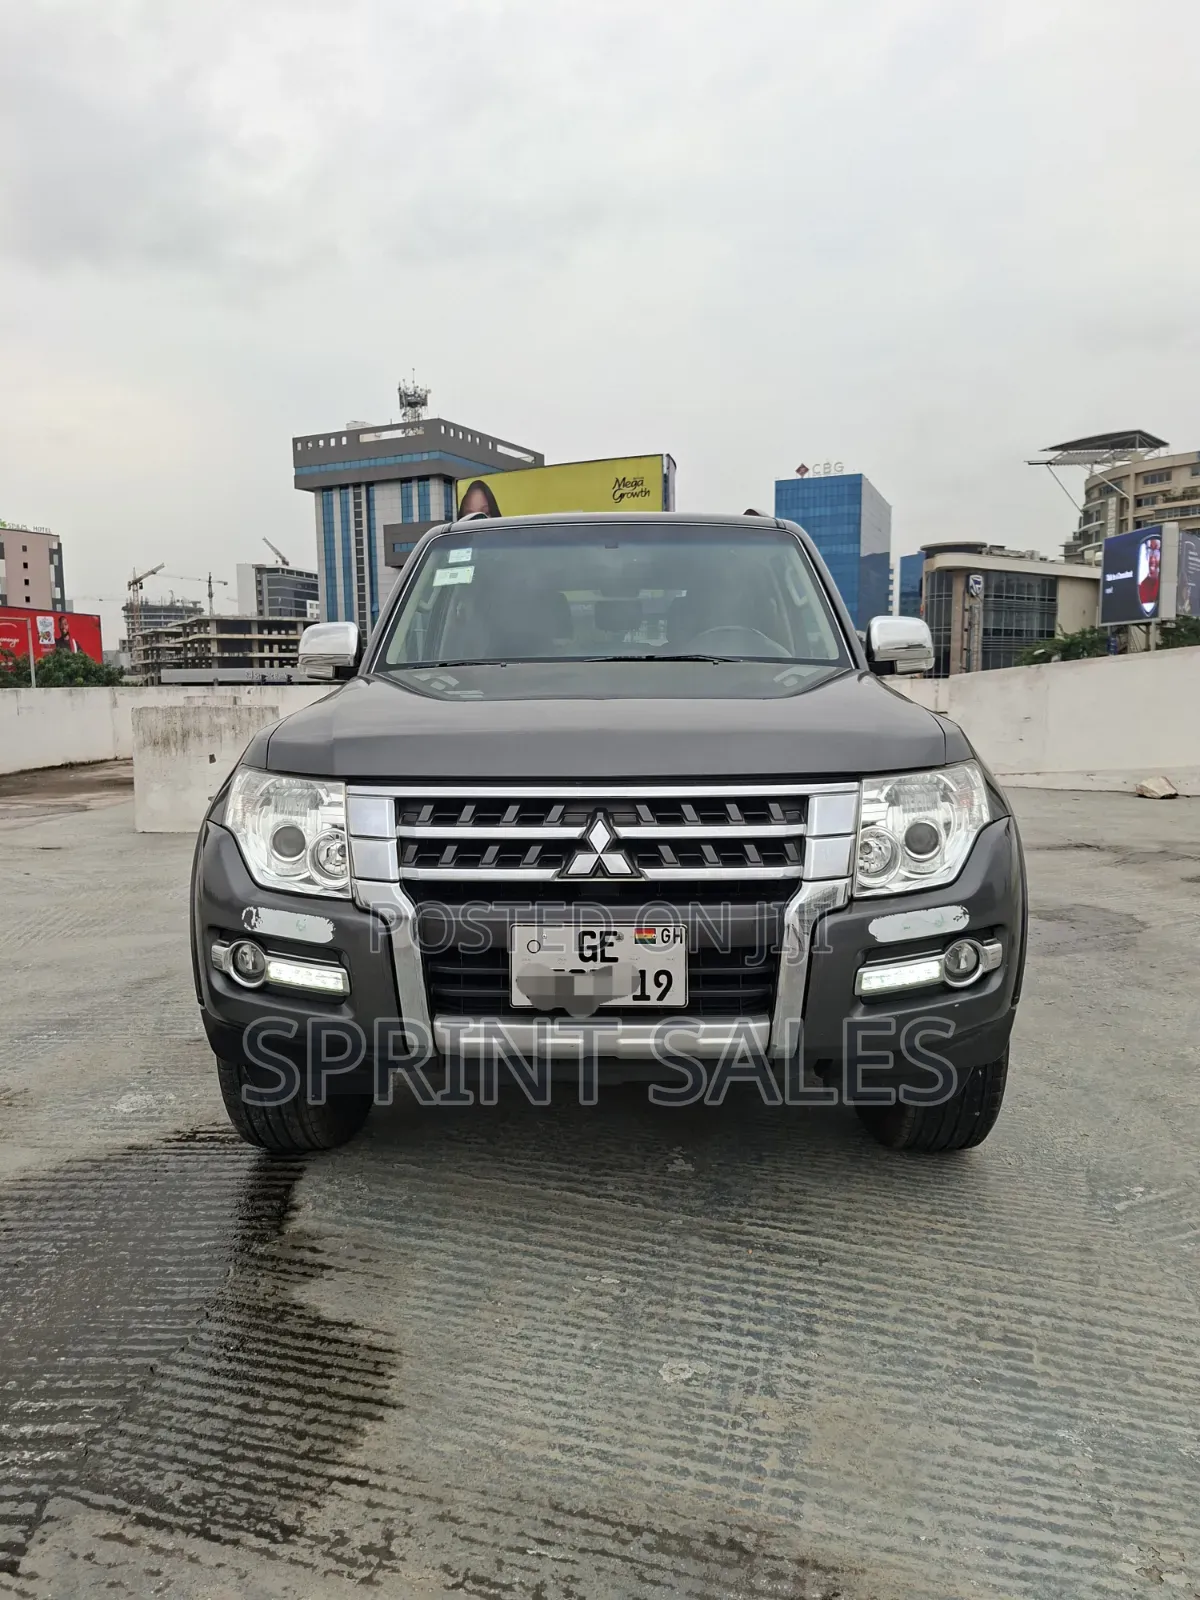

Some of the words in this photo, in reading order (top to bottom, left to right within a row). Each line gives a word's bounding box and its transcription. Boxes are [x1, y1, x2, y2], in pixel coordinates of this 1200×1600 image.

[812, 461, 845, 475] CBG
[612, 476, 644, 491] Mega
[612, 488, 651, 503] Growth
[578, 930, 619, 963] GE
[660, 927, 683, 944] GH
[632, 969, 673, 1001] 19
